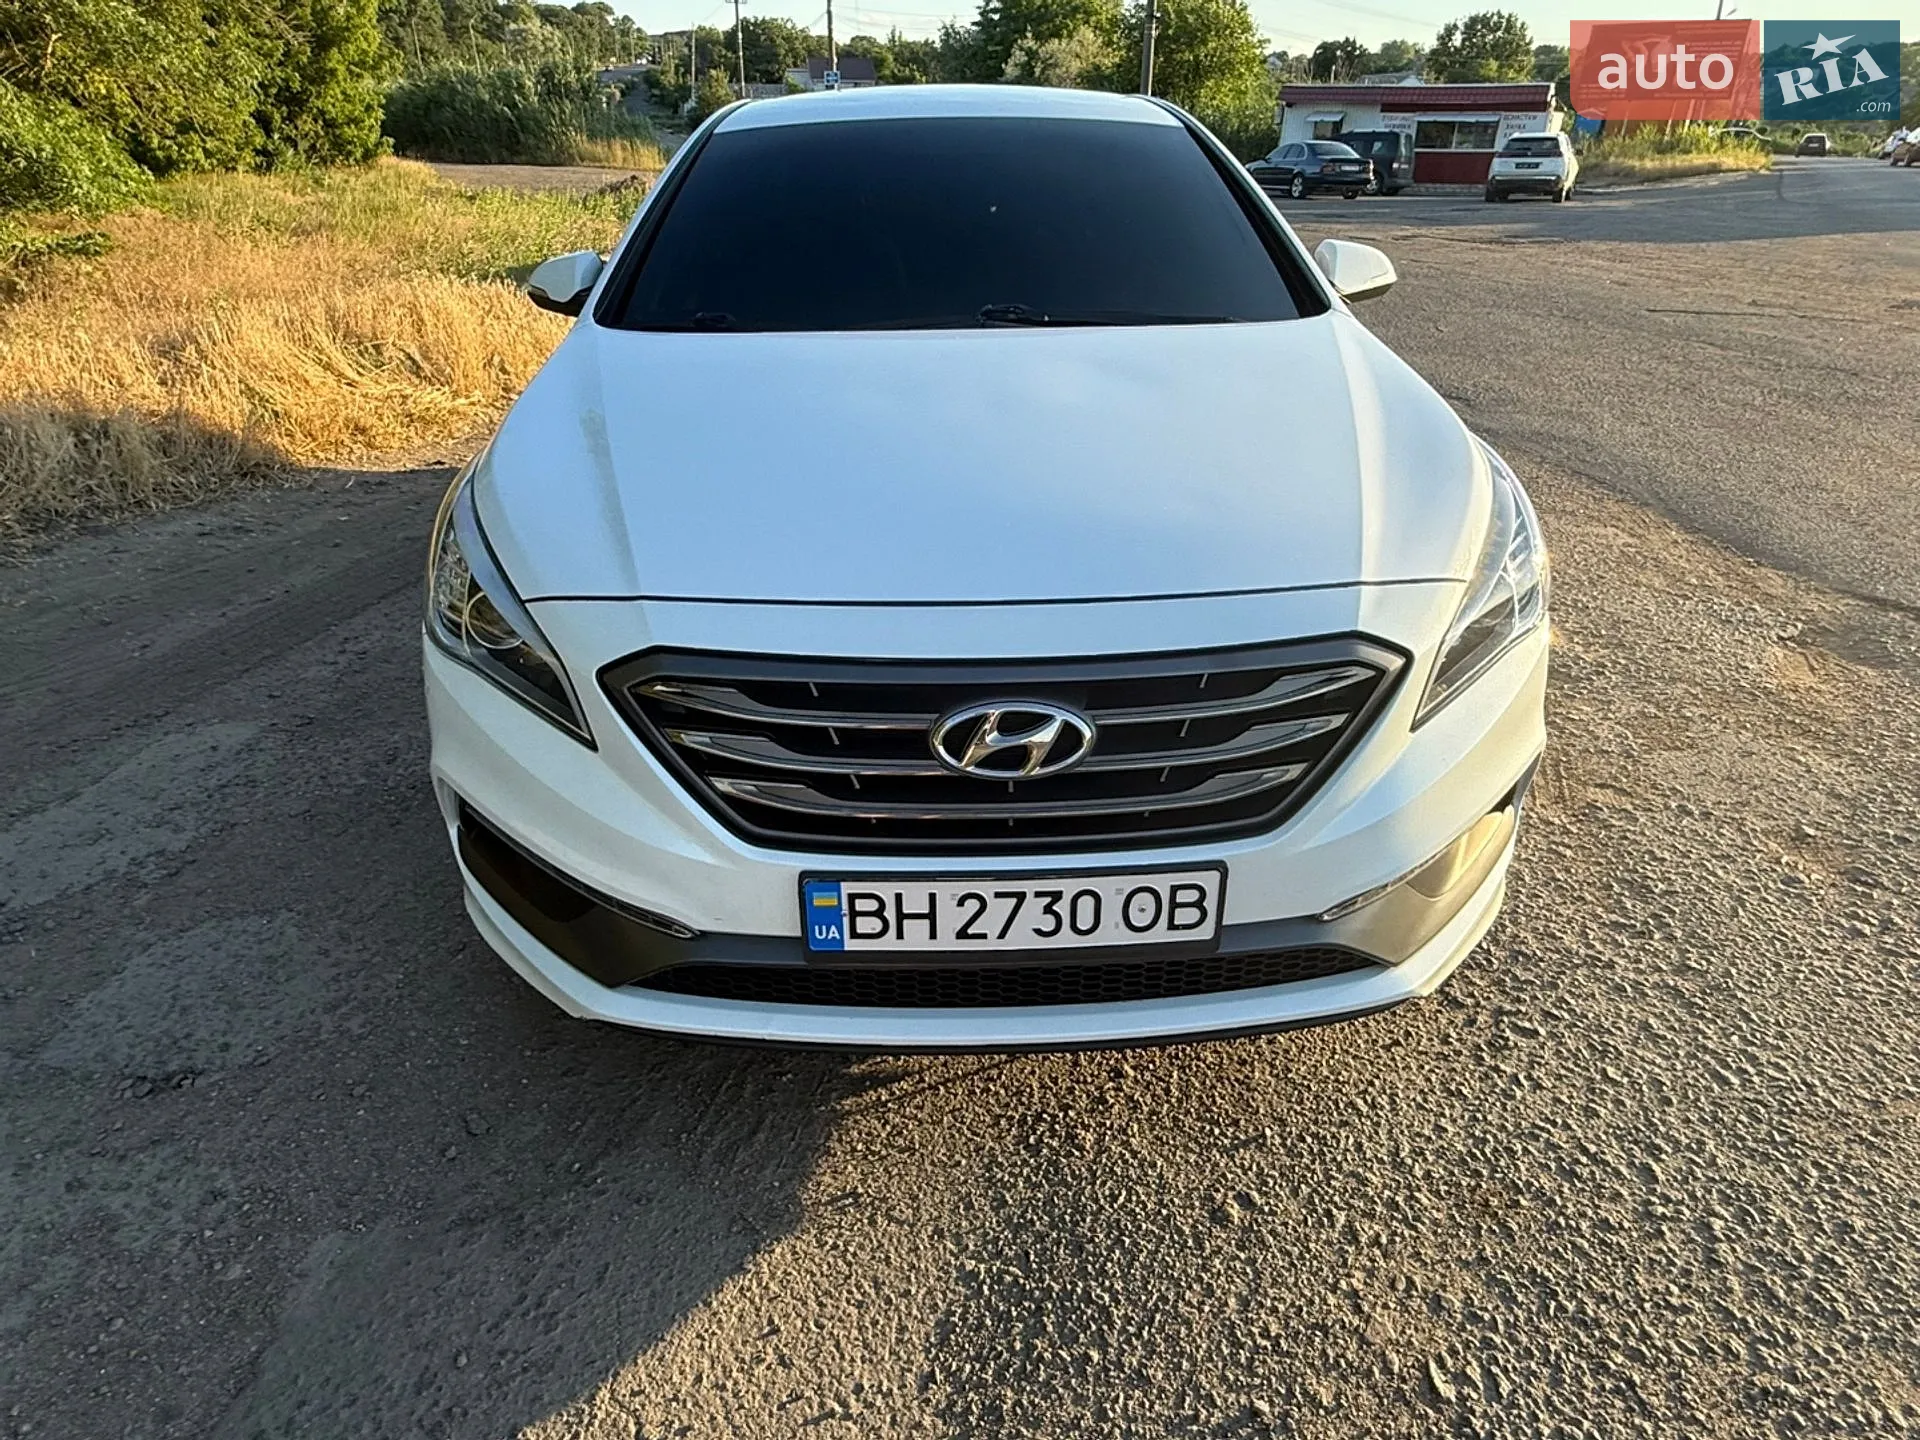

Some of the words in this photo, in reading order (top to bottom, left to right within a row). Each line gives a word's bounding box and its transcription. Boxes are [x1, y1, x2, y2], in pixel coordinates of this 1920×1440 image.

[847, 891, 937, 940] BH
[955, 888, 1101, 940] 2730
[1121, 883, 1209, 933] OB
[814, 926, 840, 940] UA
